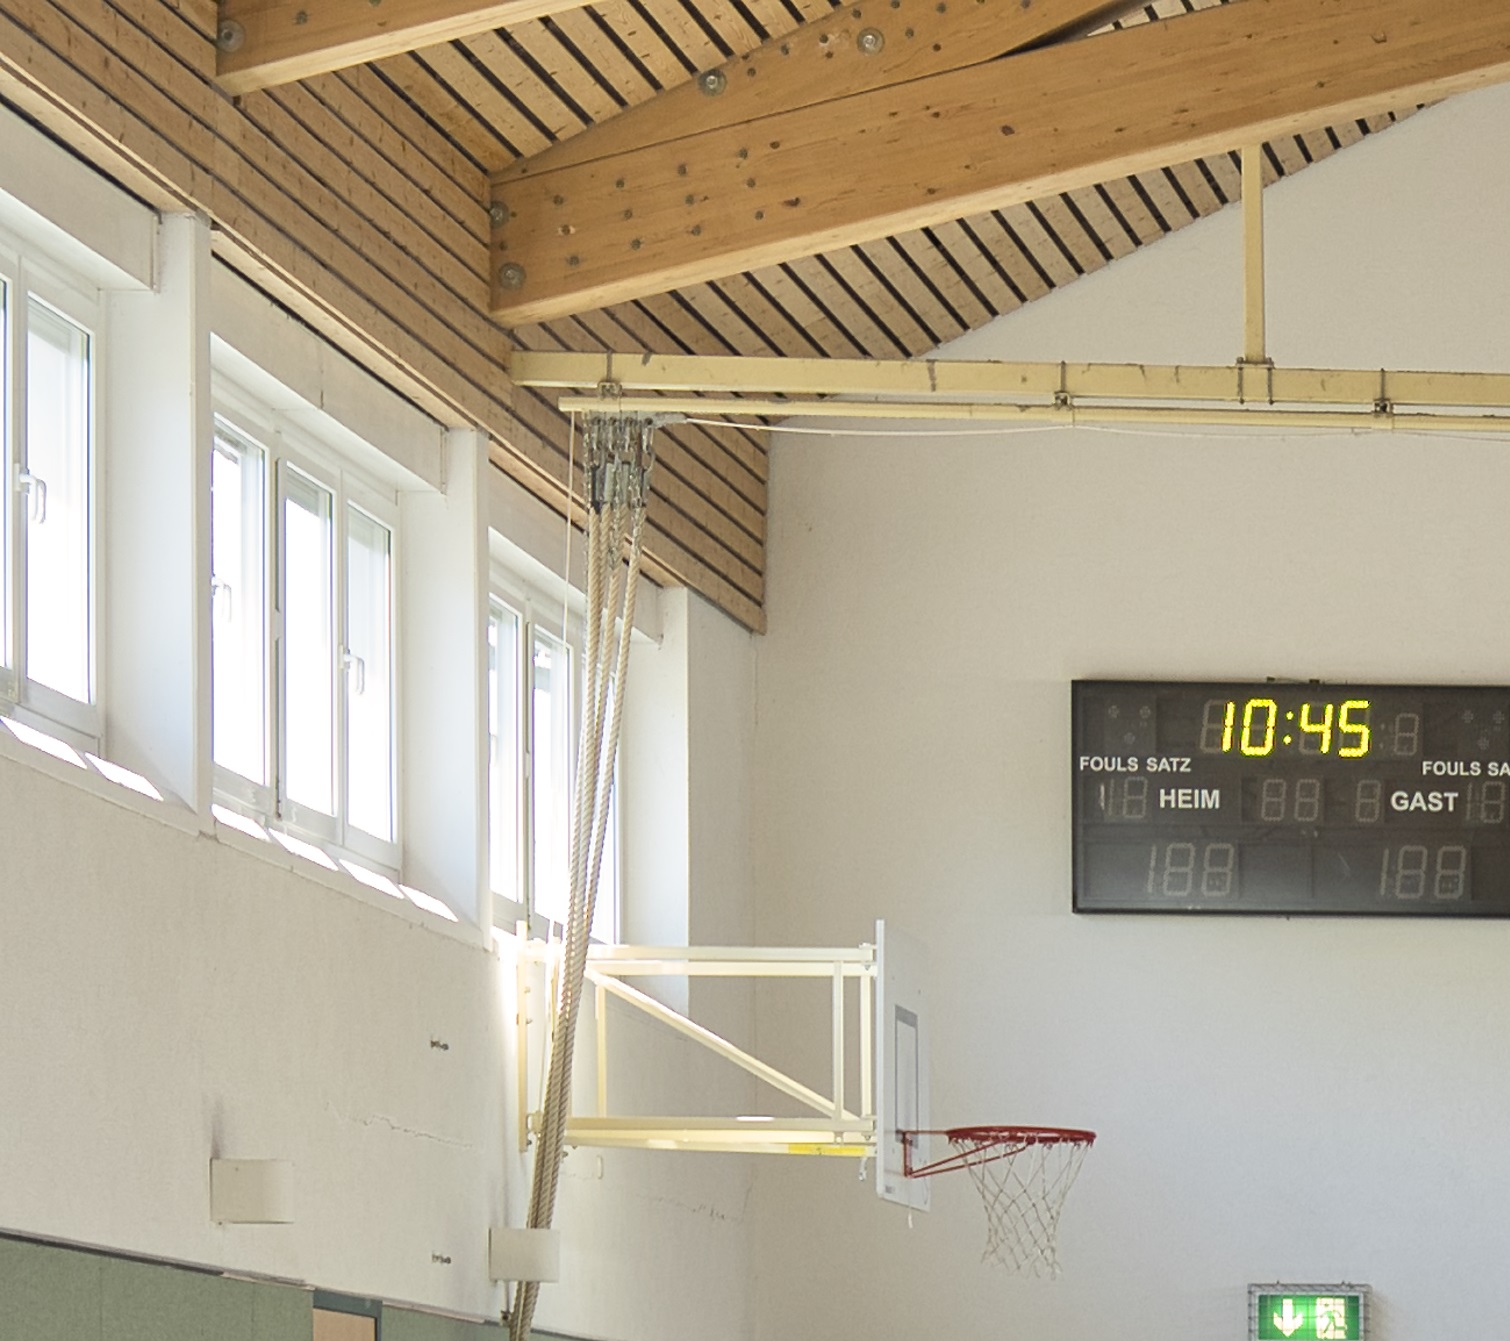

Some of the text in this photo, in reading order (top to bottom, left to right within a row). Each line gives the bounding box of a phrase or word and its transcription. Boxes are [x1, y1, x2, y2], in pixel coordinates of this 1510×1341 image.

[1221, 699, 1370, 758] 10:45
[1080, 757, 1191, 772] FOULS SATZ
[1423, 761, 1481, 776] FOULS
[1160, 789, 1220, 809] HEIM
[1391, 792, 1458, 812] GAST
